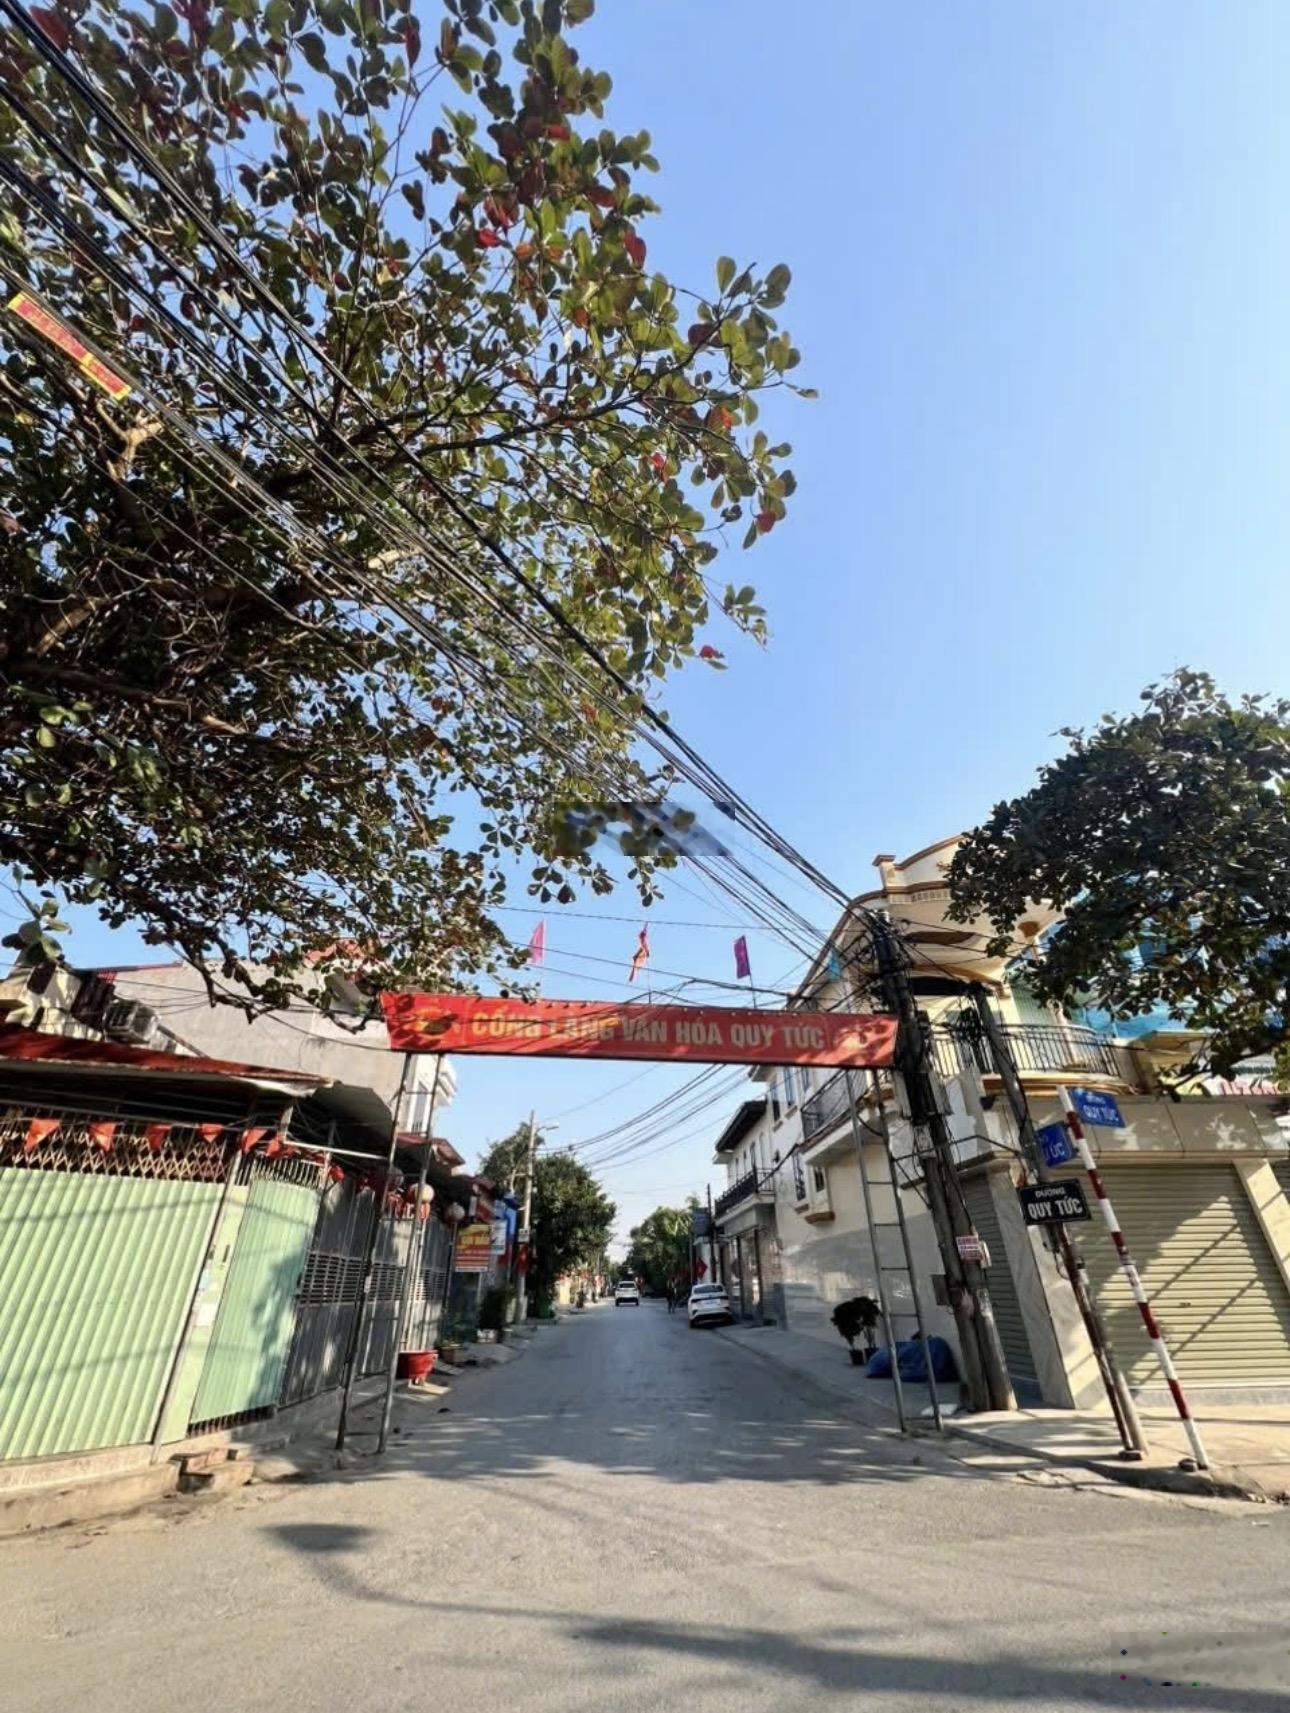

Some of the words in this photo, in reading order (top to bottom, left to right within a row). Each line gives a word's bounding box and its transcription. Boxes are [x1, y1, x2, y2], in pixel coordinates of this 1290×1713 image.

[675, 1017, 723, 1045] HÓA
[730, 1023, 774, 1049] QUY
[781, 1022, 825, 1050] TỨC
[1028, 1201, 1052, 1220] QUY
[1054, 1195, 1083, 1215] TỨC
